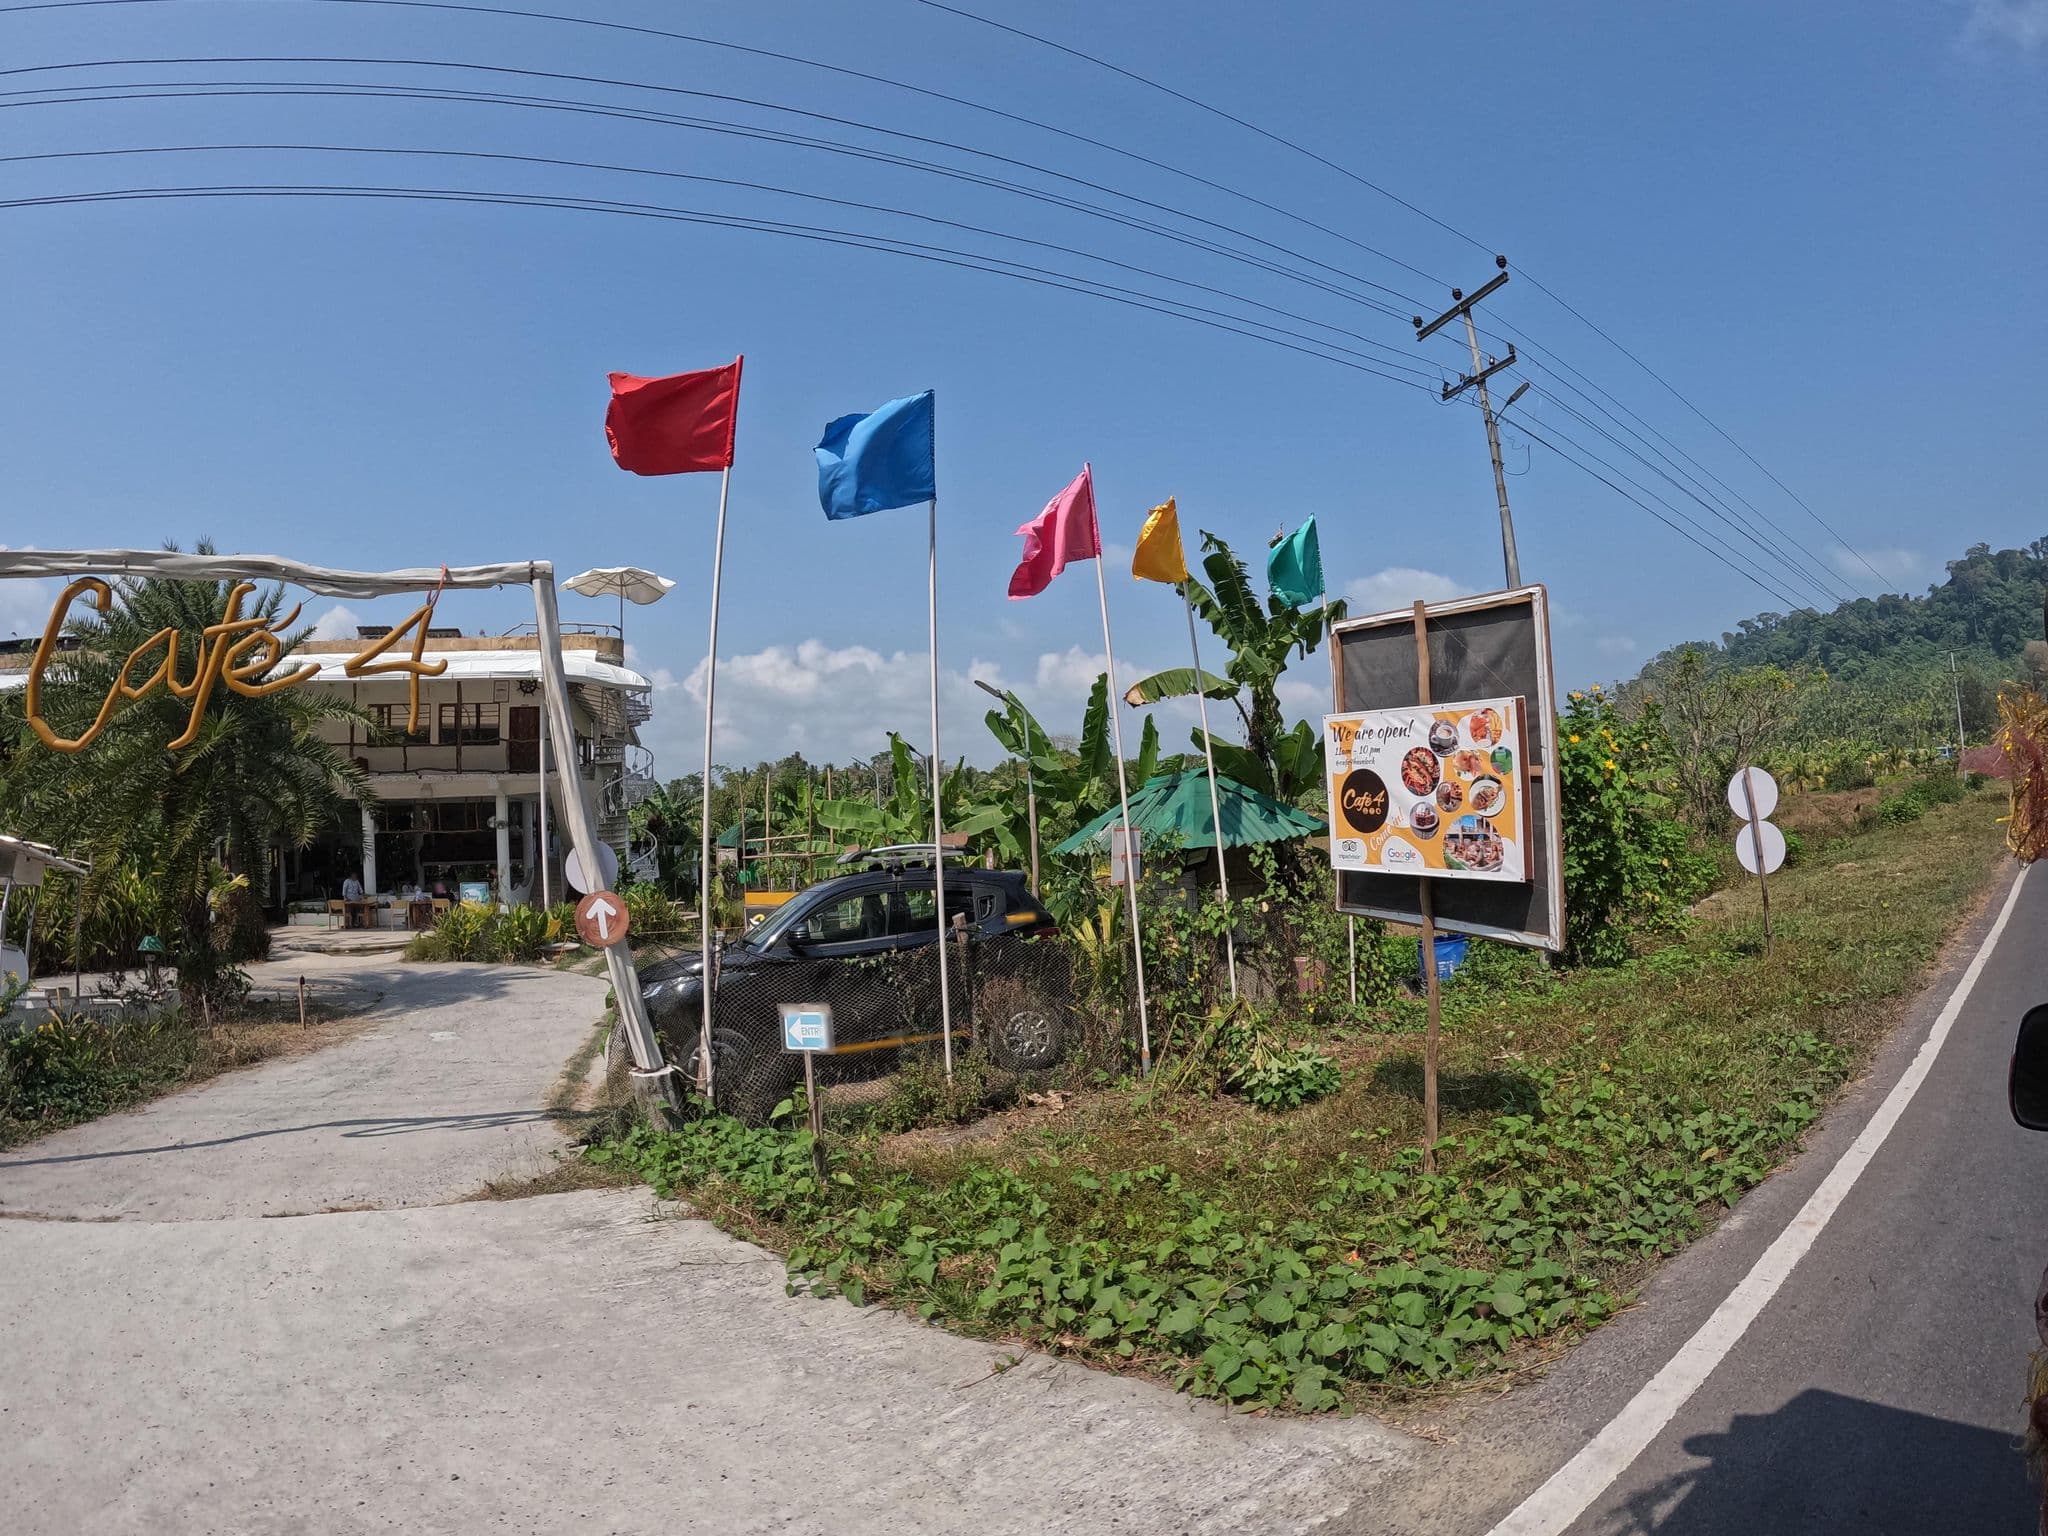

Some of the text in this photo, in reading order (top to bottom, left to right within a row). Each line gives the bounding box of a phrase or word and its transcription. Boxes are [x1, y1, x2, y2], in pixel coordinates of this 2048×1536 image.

[27, 576, 448, 753] Café 4
[1333, 719, 1414, 744] We are open!
[1358, 745, 1368, 755] 10
[1369, 747, 1381, 756] pm
[1343, 788, 1385, 811] Café 4
[1369, 825, 1392, 851] Come
[1387, 848, 1416, 860] Google
